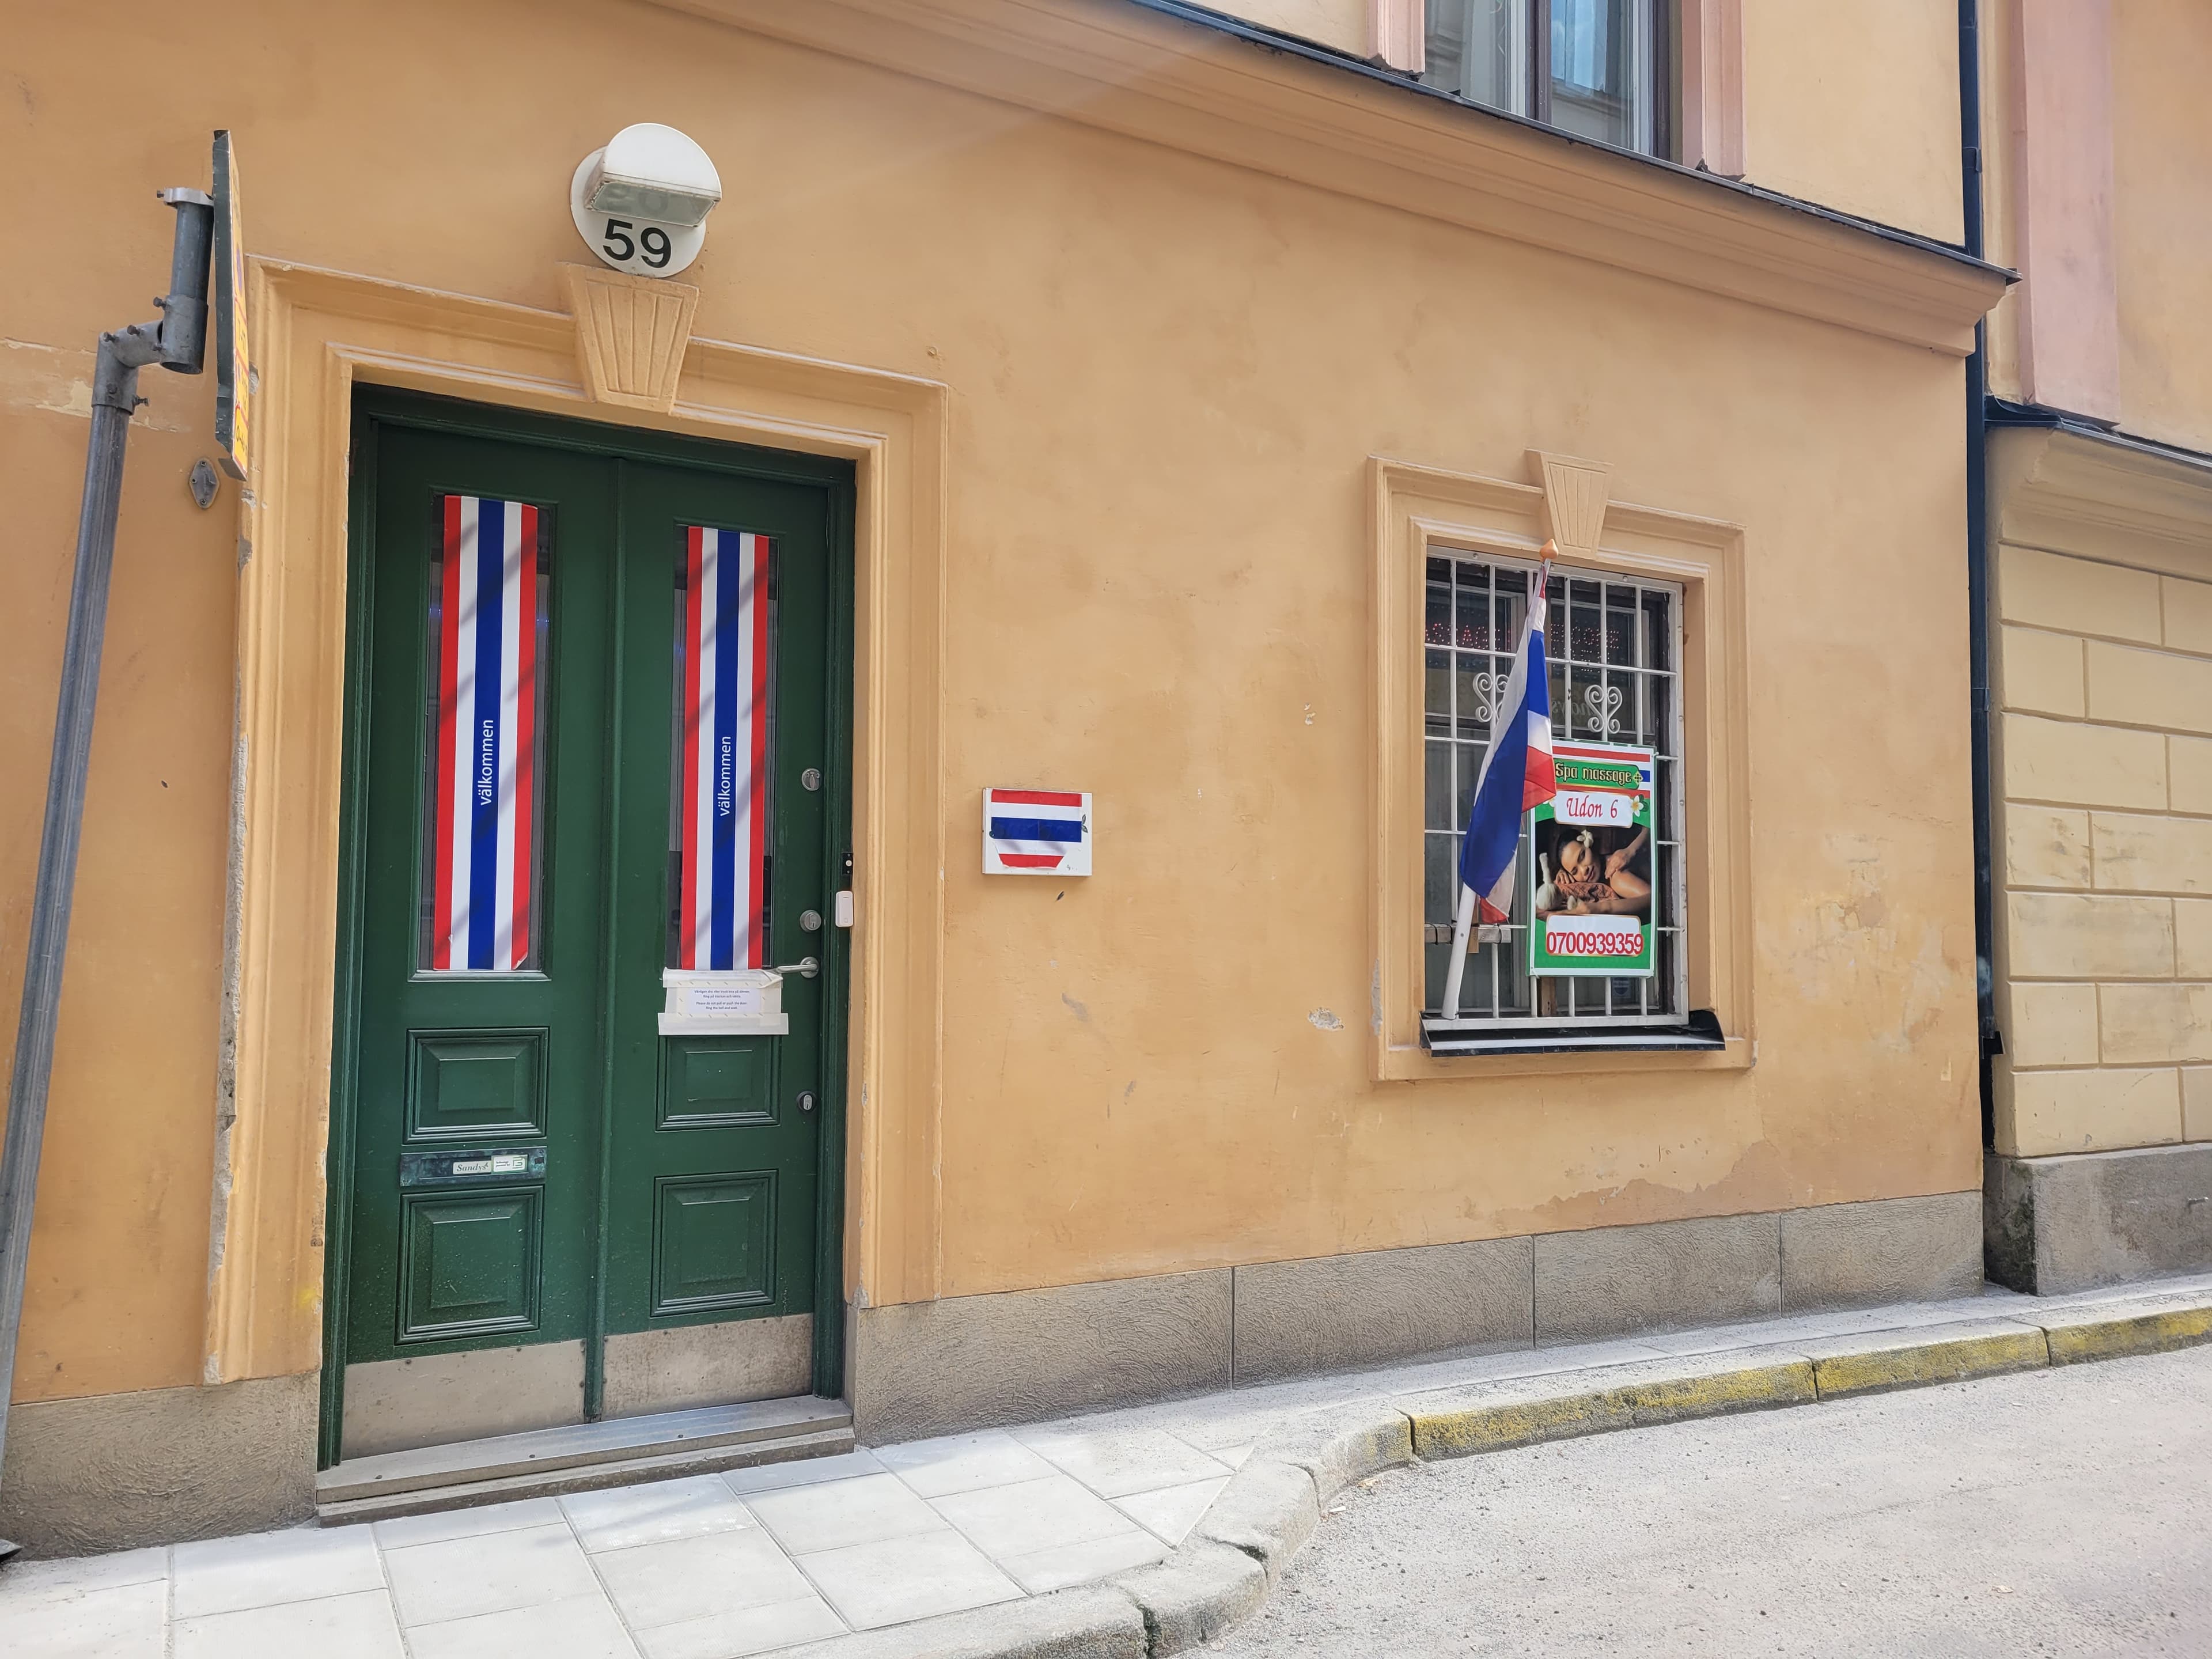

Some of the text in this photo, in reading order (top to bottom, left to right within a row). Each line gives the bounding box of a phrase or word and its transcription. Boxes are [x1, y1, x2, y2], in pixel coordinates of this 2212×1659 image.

[603, 218, 672, 268] 59
[477, 719, 494, 806] välkommen
[717, 736, 731, 816] välkommen
[1555, 762, 1633, 786] Spa massage
[1566, 794, 1619, 819] Udon 6
[1546, 931, 1644, 955] 0700939359
